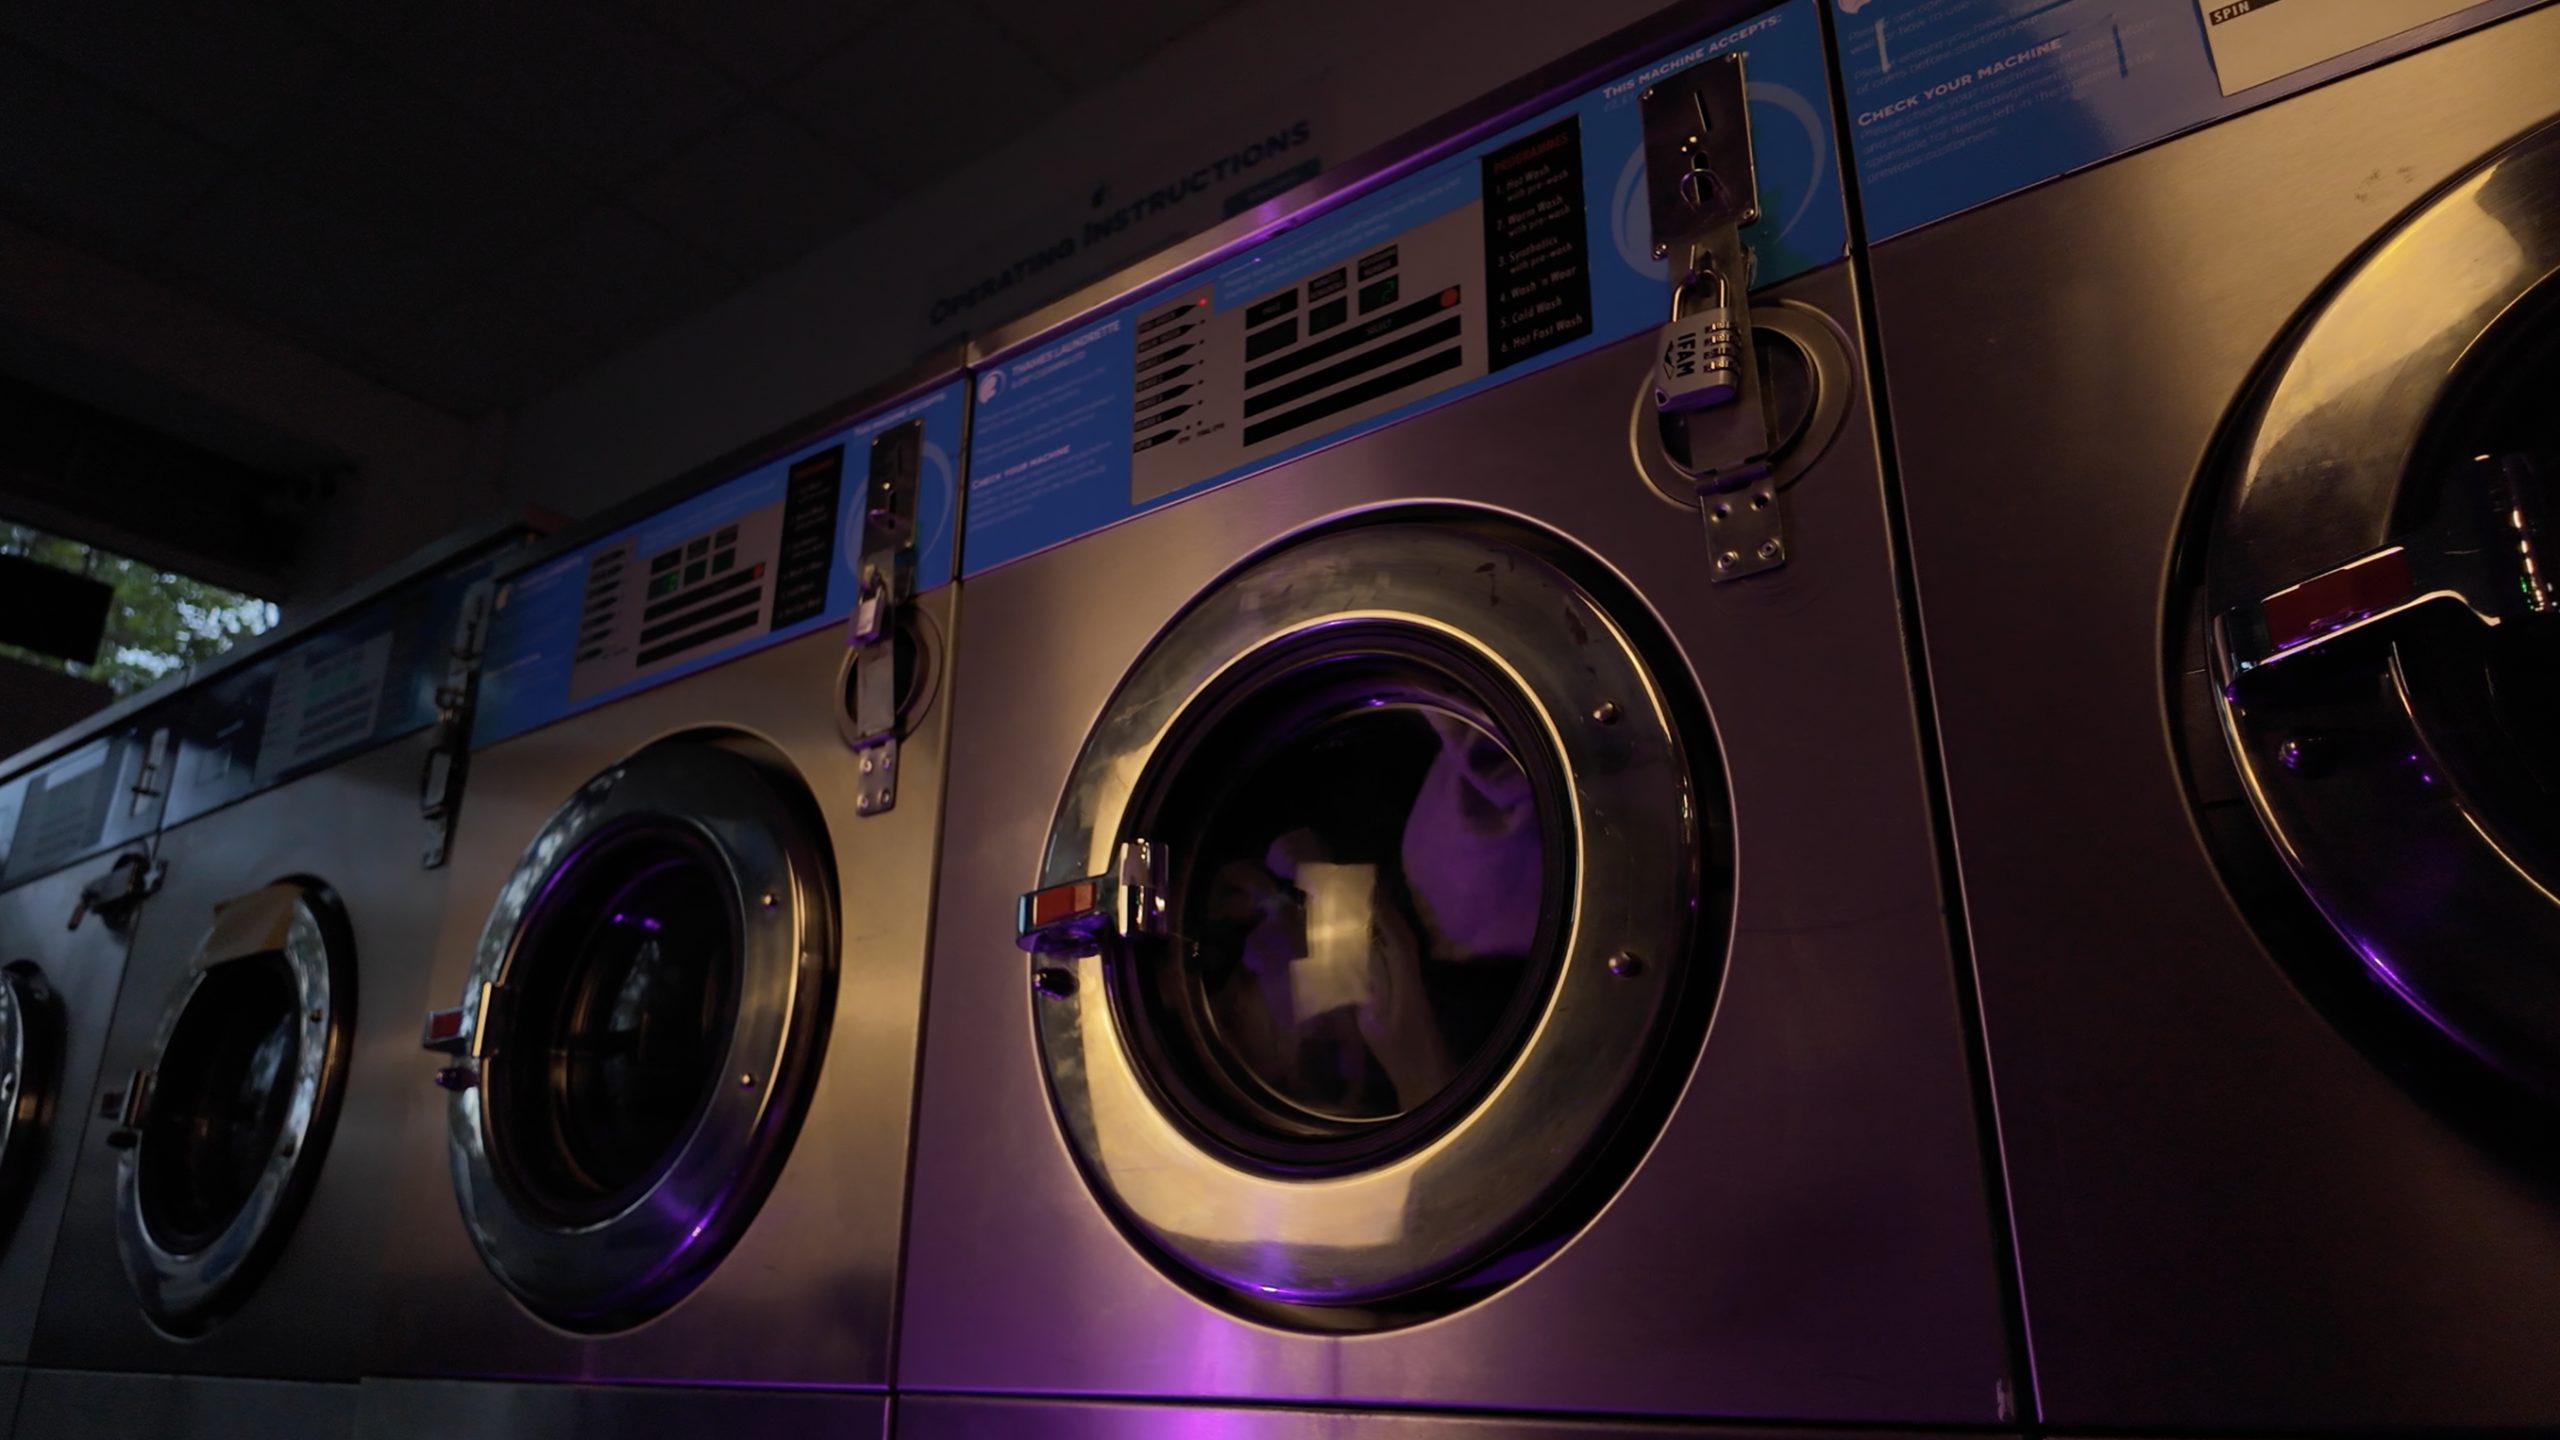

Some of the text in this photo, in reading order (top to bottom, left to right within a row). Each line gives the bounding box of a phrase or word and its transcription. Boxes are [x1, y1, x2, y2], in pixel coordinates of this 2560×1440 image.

[2213, 1, 2250, 23] SPIN
[1603, 14, 1783, 99] THIS MACHINE ACCEPTS:
[1857, 95, 1919, 127] CHECK
[1923, 74, 1973, 100] YOUR
[1977, 38, 2063, 81] MACHINE
[1525, 163, 1550, 182] Wash
[930, 238, 1075, 327] OPERATING
[1083, 120, 1312, 247] INSTRUCTIONS
[1507, 208, 1535, 225] Warm
[1537, 194, 1563, 212] Wash
[1508, 236, 1558, 264] Synthetics
[1510, 281, 1537, 299] Wash
[1550, 265, 1577, 284] Wear
[1511, 306, 1535, 324] Cold
[1536, 295, 1563, 314] Wash
[1513, 333, 1531, 349] Hot
[1532, 324, 1554, 341] Fast
[1556, 313, 1583, 332] Wash
[1677, 332, 1696, 378] IFAM
